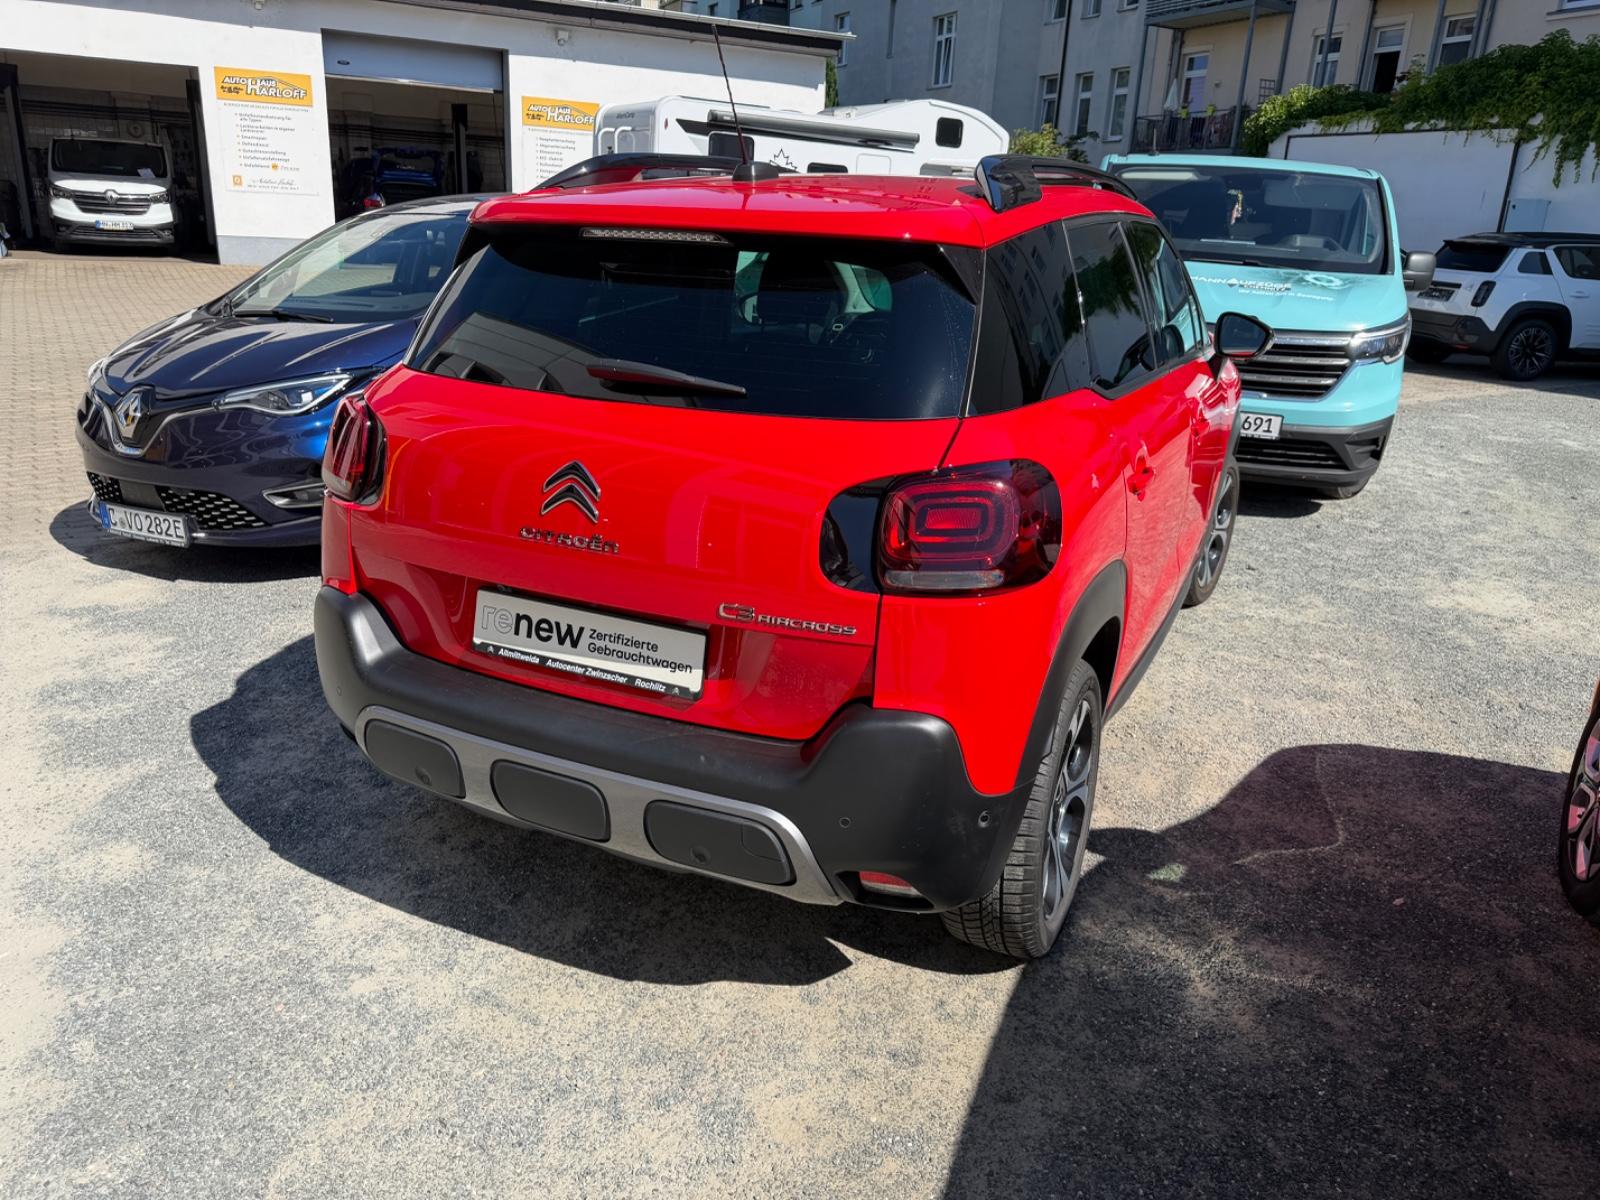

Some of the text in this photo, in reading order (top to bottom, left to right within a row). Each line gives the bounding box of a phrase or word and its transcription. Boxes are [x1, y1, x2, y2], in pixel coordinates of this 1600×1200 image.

[246, 78, 308, 99] HARLOFF
[1242, 415, 1273, 433] 691
[109, 507, 117, 527] C
[124, 510, 143, 532] VO
[145, 514, 184, 539] 282E
[481, 604, 585, 649] renew
[718, 602, 857, 636] C3 AIRCROSS
[589, 628, 659, 652] Zertifizierte
[588, 642, 693, 674] Gebrauchtwagen
[546, 658, 586, 674] Autocenter
[635, 678, 667, 692] Rochlitz
